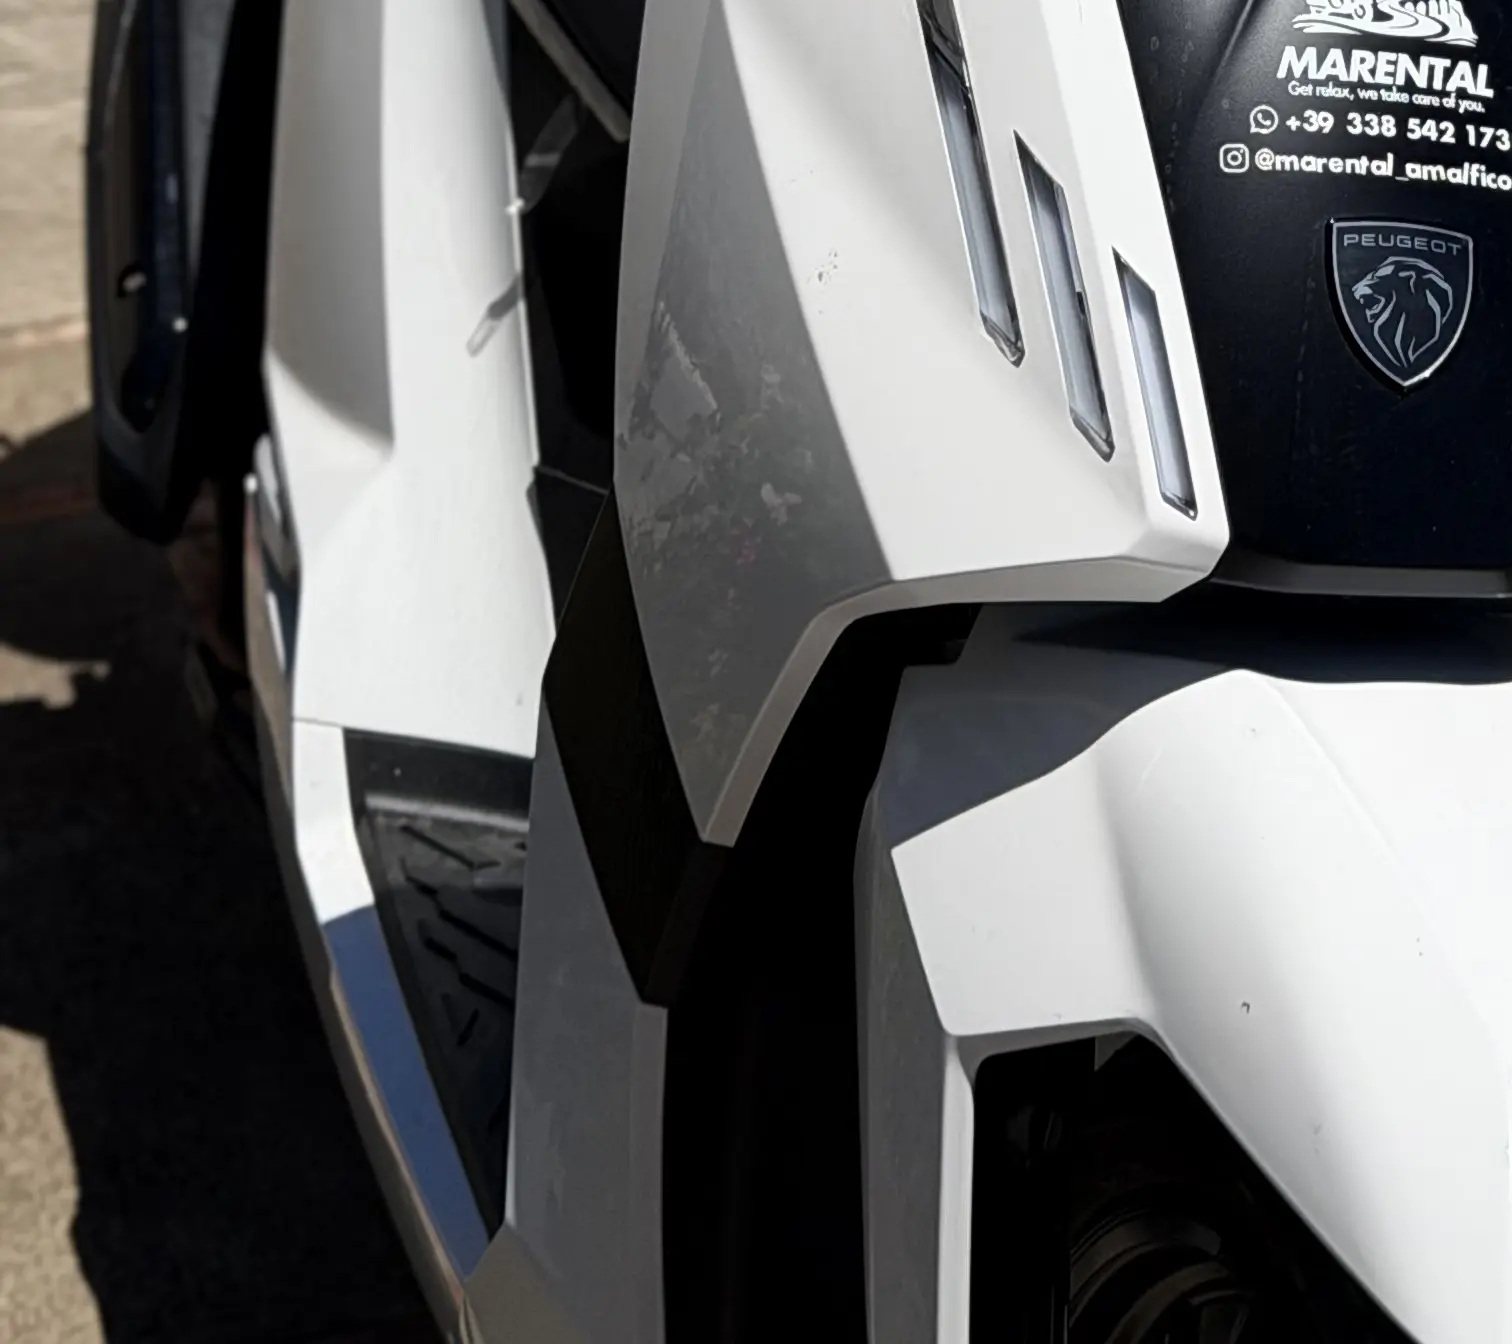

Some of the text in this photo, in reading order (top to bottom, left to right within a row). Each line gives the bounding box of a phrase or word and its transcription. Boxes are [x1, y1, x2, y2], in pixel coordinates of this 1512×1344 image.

[1276, 45, 1494, 99] MARENTAL
[1287, 80, 1486, 114] Get relax, we take care of you.
[1284, 109, 1335, 134] +39
[1346, 112, 1397, 138] 338
[1406, 117, 1456, 144] 542
[1343, 233, 1463, 256] PEUGEOT
